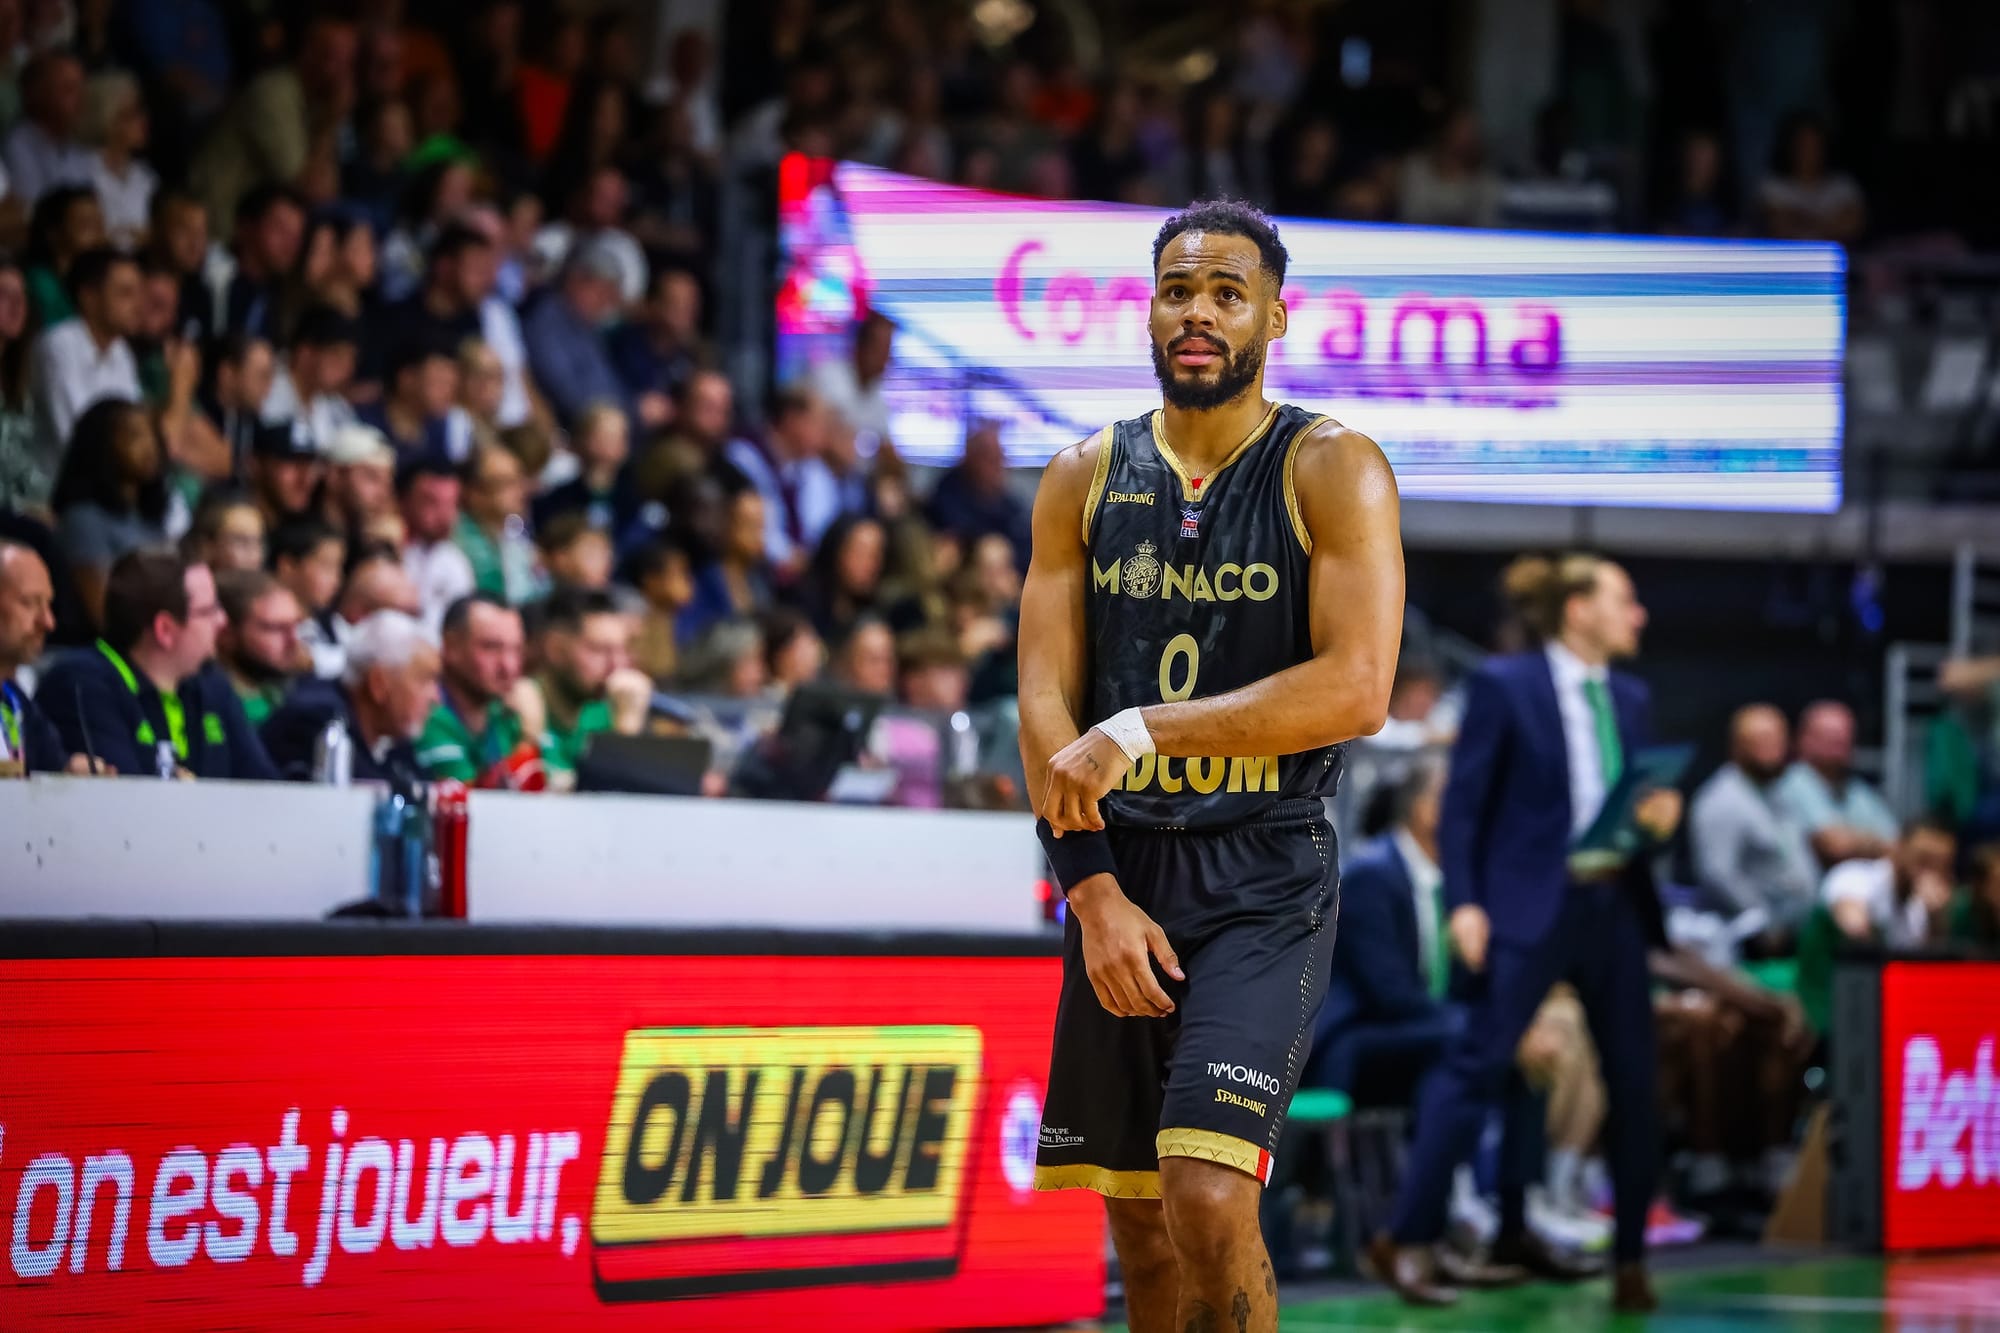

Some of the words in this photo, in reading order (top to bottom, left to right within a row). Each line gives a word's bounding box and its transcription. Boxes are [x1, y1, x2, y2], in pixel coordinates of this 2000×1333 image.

[1106, 490, 1156, 506] SPALDING
[1092, 556, 1280, 602] MONACO
[1158, 633, 1200, 703] 0
[1112, 751, 1280, 794] DCOM
[758, 1063, 959, 1199] JOUE
[1214, 1088, 1267, 1118] SPALDING
[1898, 1034, 2000, 1191] Bet
[0, 1120, 136, 1279] on
[146, 1106, 310, 1268] est
[302, 1106, 581, 1288] joueur,
